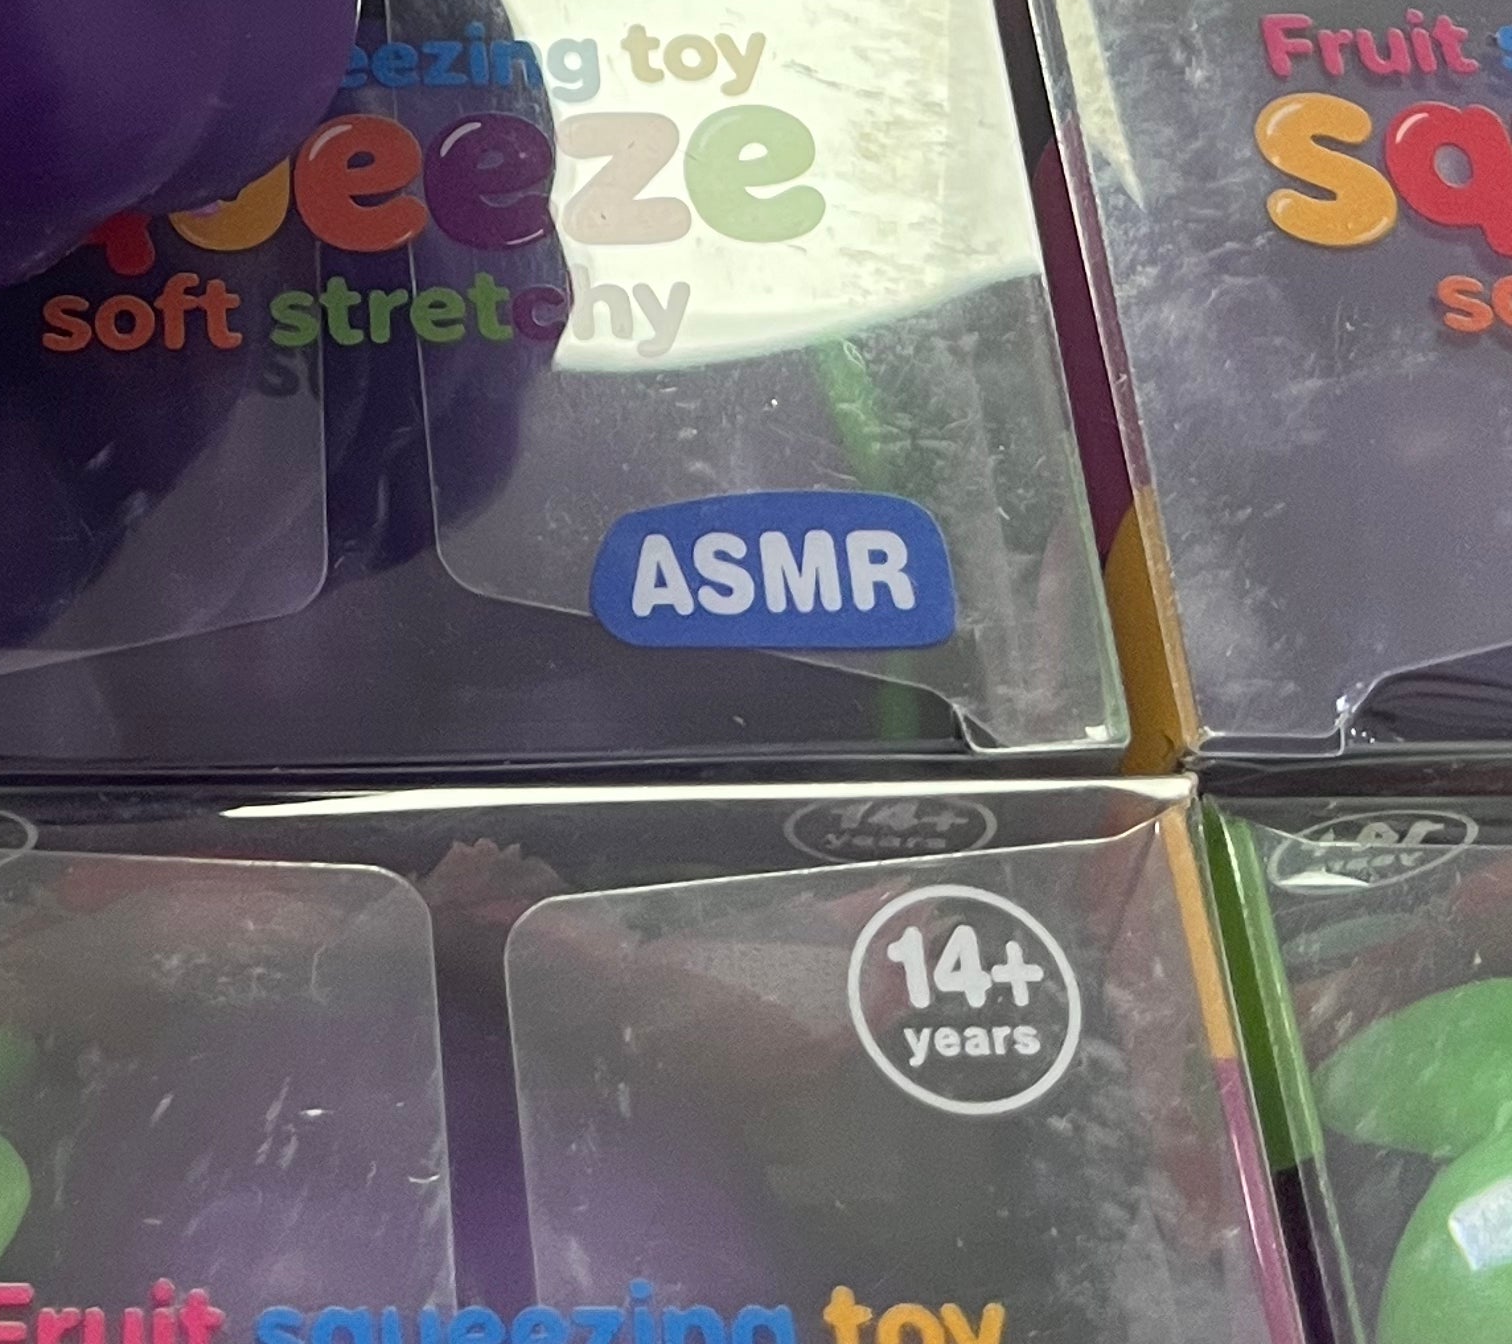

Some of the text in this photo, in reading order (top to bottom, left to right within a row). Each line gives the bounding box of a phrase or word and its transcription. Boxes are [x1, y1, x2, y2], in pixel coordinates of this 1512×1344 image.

[341, 21, 766, 102] ezing toy
[1260, 9, 1479, 77] Fruit
[85, 104, 826, 275] eeze
[42, 262, 691, 358] soft stretchy
[632, 529, 916, 617] ASMR
[887, 924, 1044, 1008] 14+
[903, 1025, 1040, 1067] years
